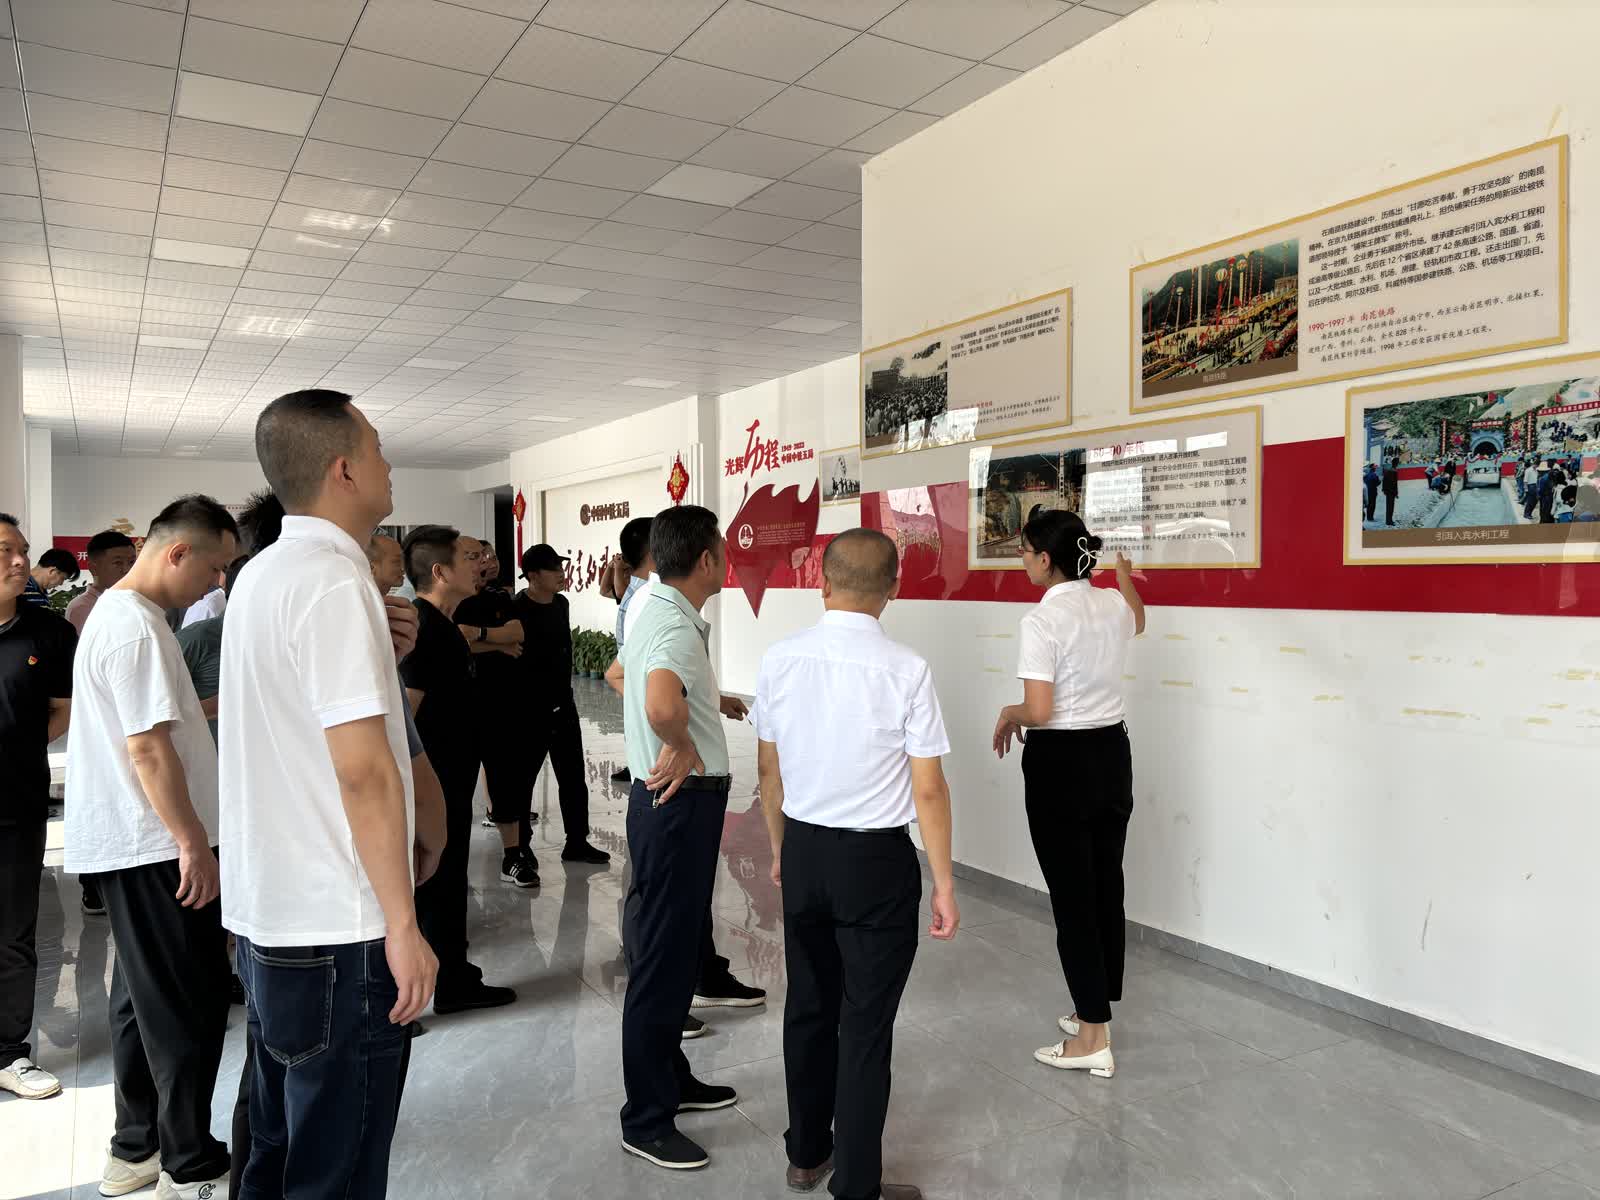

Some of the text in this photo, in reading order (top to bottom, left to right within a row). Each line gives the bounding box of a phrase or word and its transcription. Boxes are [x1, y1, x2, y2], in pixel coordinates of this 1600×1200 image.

[1435, 529, 1510, 542] 引洱入宾水利工程
